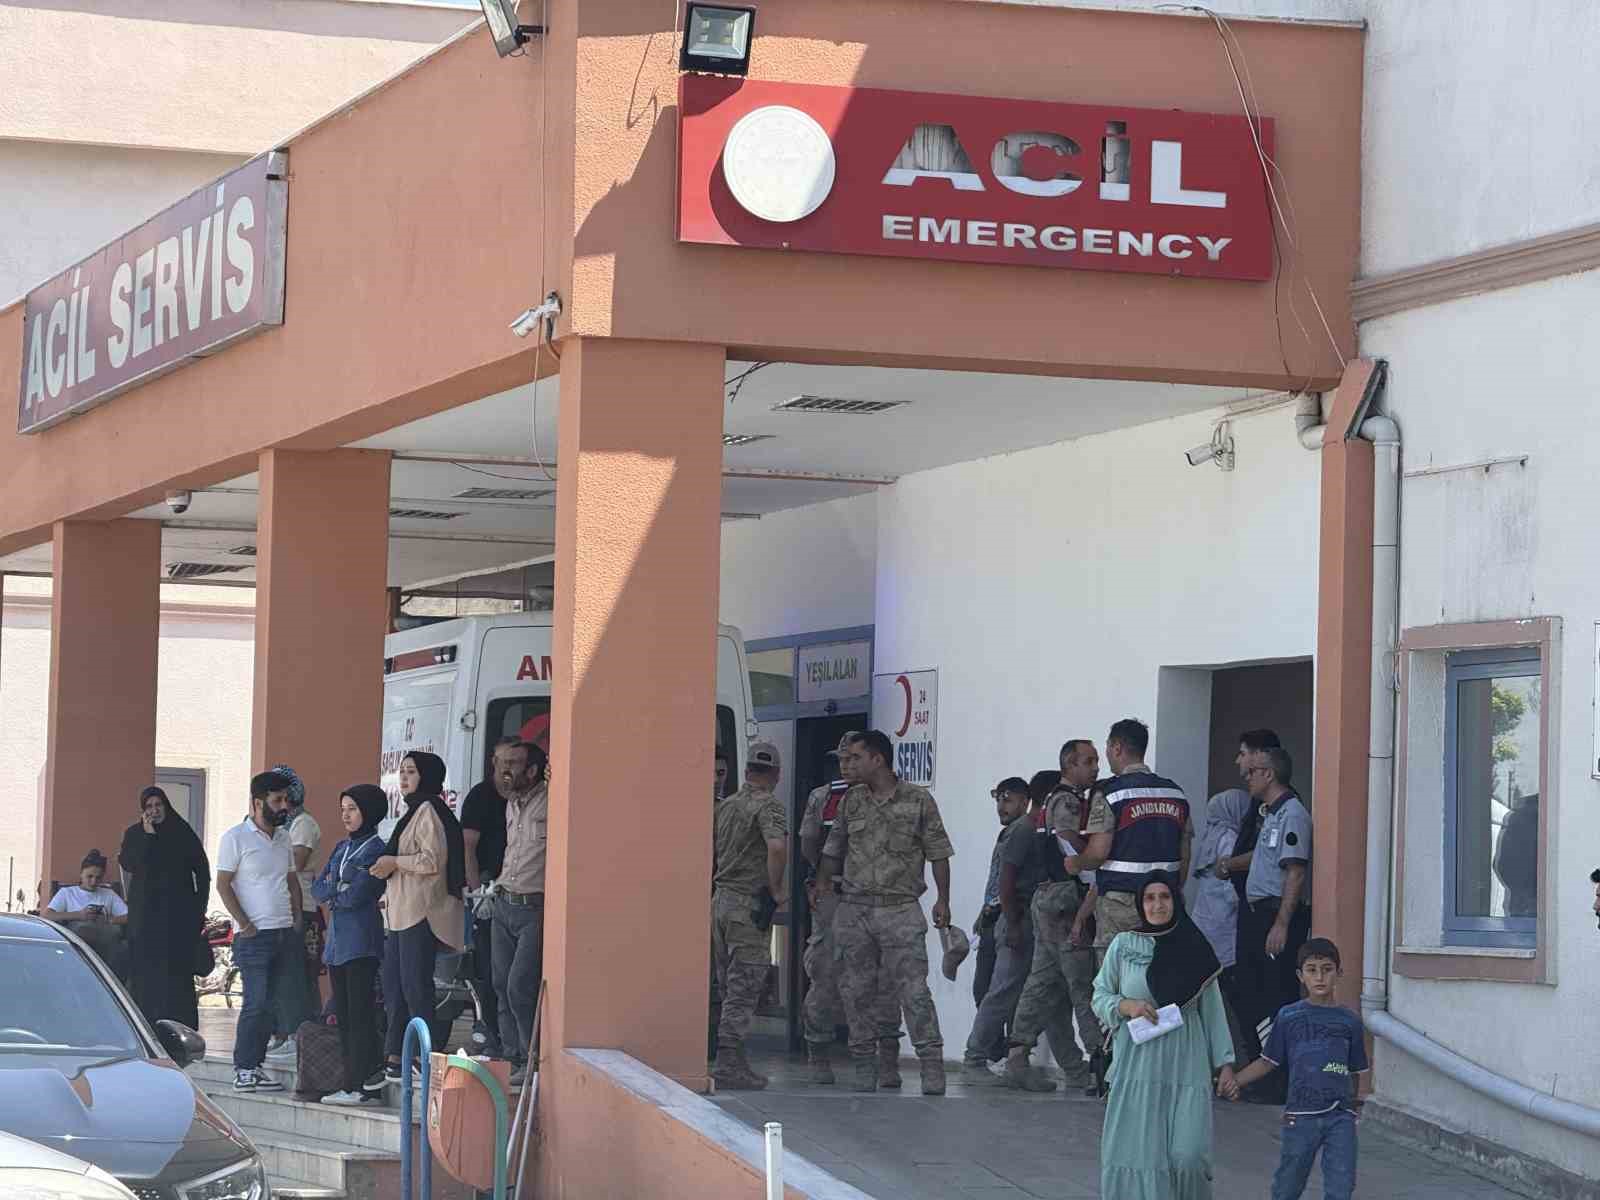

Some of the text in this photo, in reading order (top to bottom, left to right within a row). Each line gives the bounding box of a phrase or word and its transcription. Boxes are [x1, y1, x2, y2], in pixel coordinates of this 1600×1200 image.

[881, 120, 1227, 208] ACİL
[881, 214, 1233, 263] EMERGENCY
[24, 182, 255, 410] ACİL SERVİS
[914, 709, 929, 726] SAAT
[896, 731, 933, 783] SERVİS
[1130, 801, 1180, 819] JANDARMA
